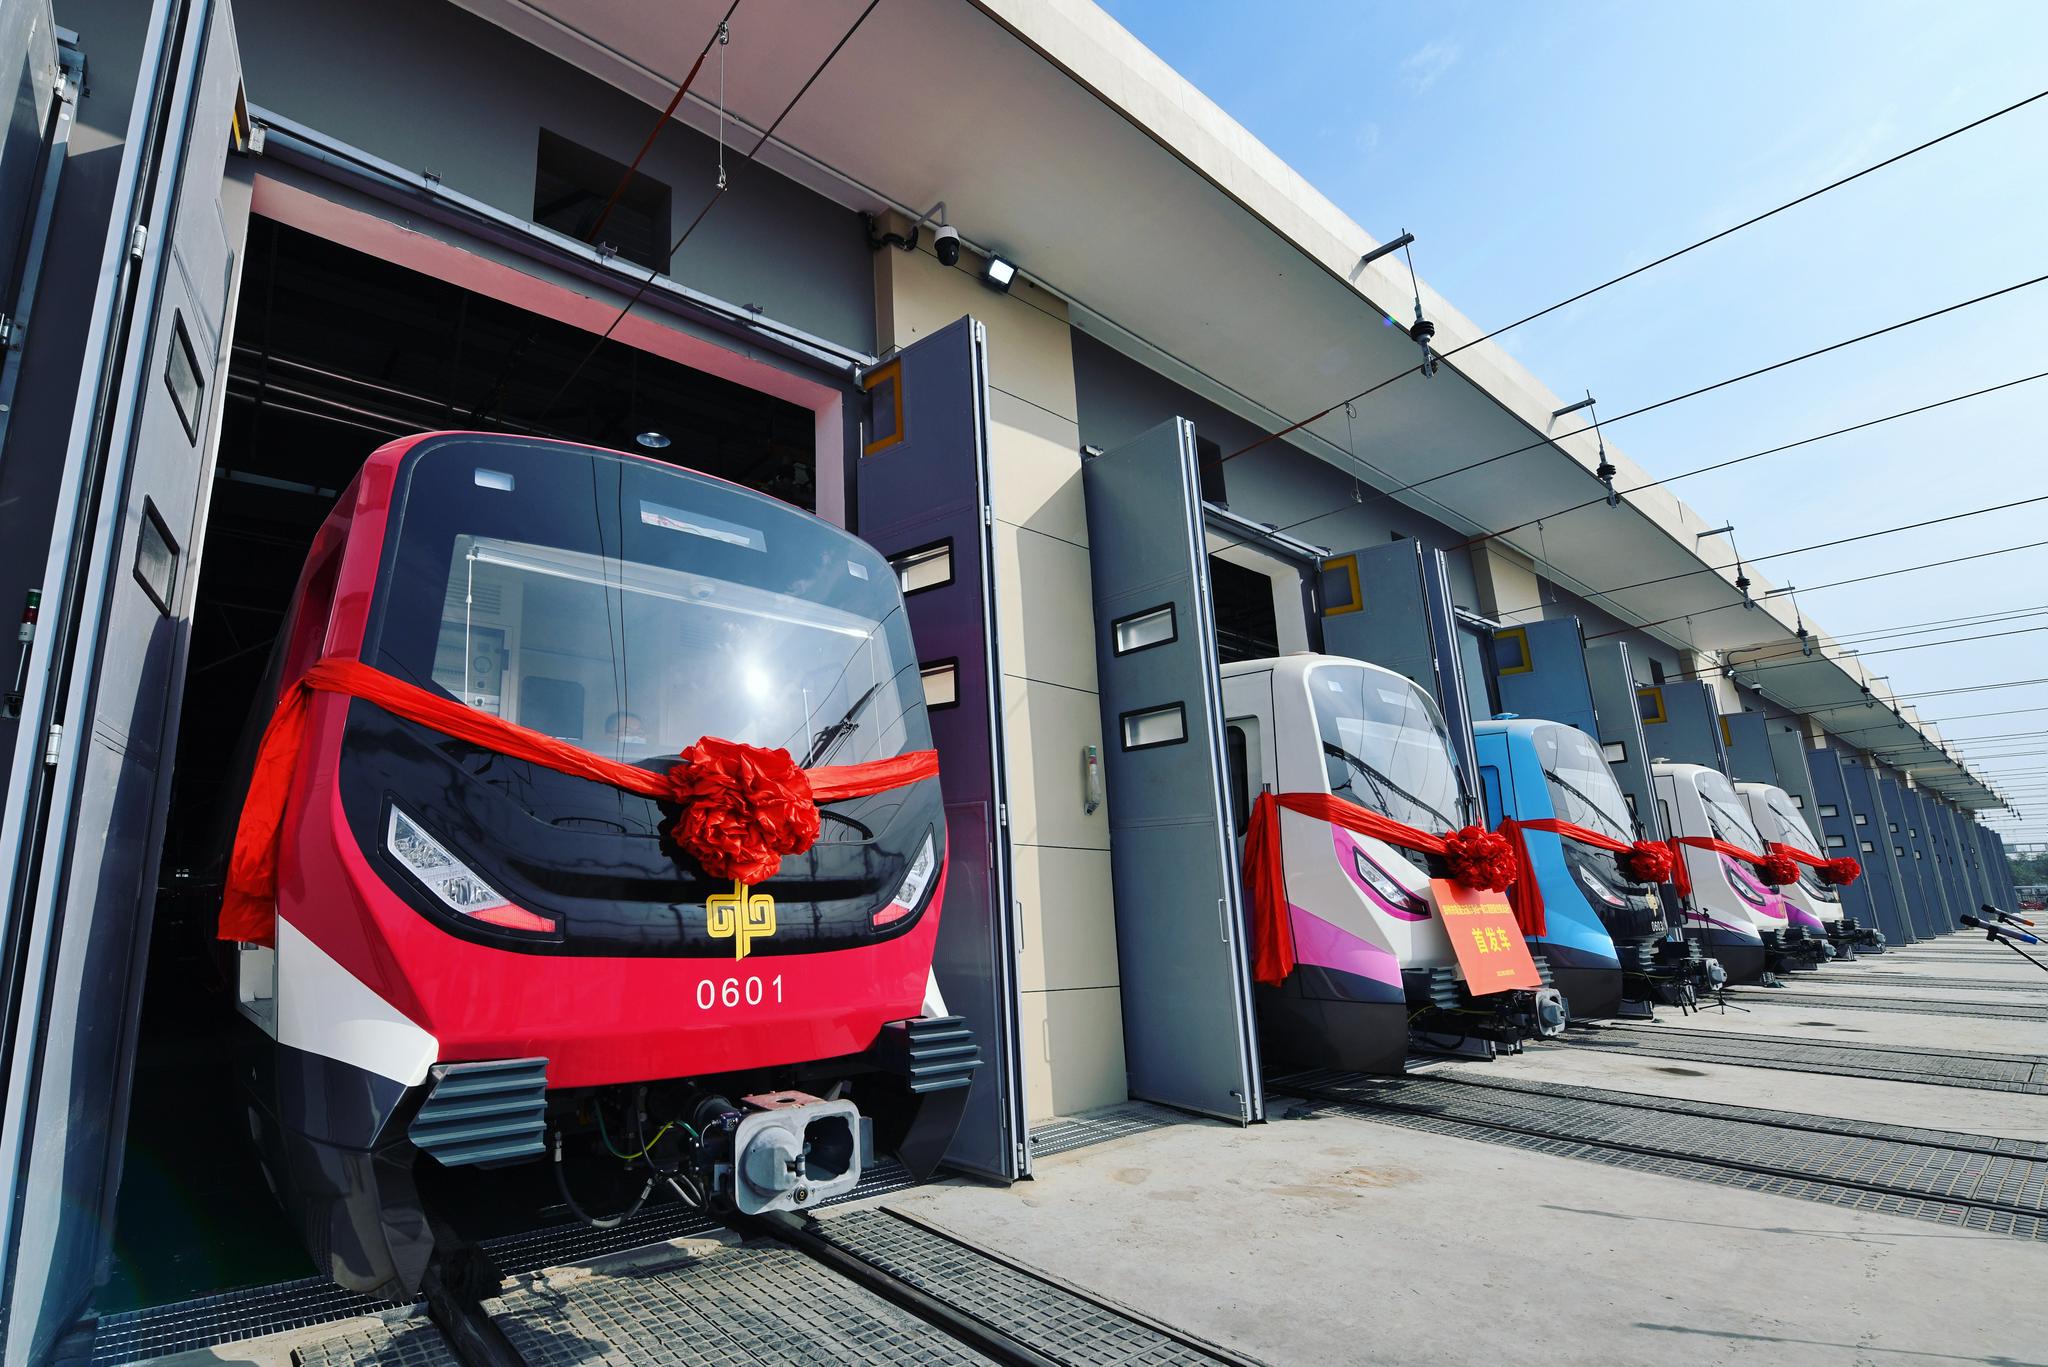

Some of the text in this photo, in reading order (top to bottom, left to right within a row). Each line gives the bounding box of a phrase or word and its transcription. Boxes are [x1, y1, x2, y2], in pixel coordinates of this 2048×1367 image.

[1471, 926, 1512, 954] 首发车
[696, 974, 782, 1010] 0601
